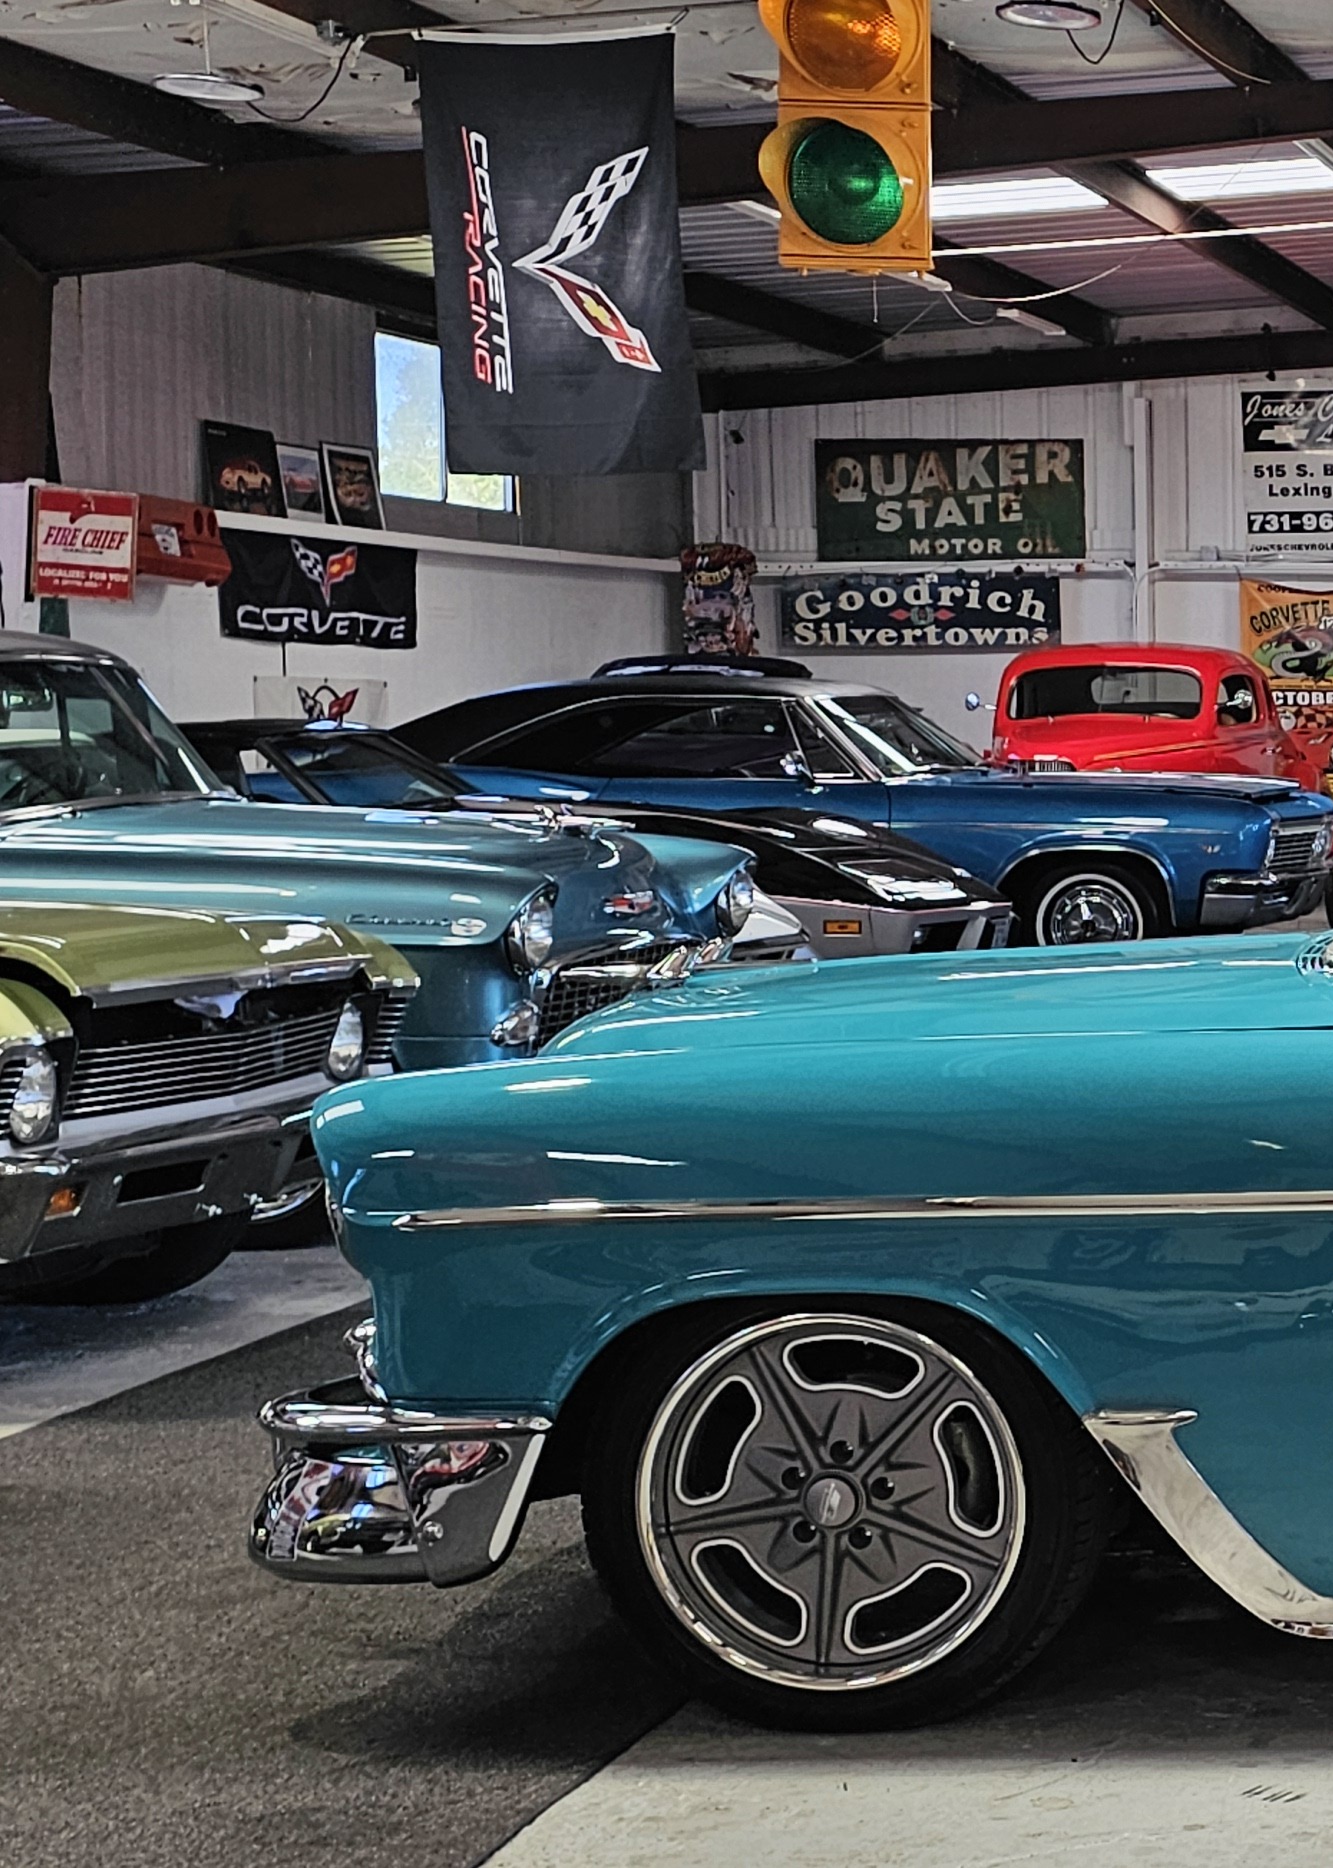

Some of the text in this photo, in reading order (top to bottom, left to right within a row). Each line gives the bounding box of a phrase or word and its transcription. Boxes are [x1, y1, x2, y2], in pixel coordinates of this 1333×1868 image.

[461, 126, 492, 385] RACING
[470, 131, 513, 394] CORVETTE
[1243, 394, 1306, 426] Jones
[826, 440, 1074, 503] QUAKER
[1253, 464, 1287, 478] 515
[1295, 463, 1314, 477] S.
[875, 492, 1024, 532] STATE
[43, 525, 129, 551] FIRE CHIEF
[909, 537, 1061, 555] MOTOR OIL
[795, 576, 1048, 623] Goodrich
[1250, 598, 1331, 636] CORVETTE
[236, 603, 407, 640] CORVETTE
[793, 621, 1049, 647] Silvertowns
